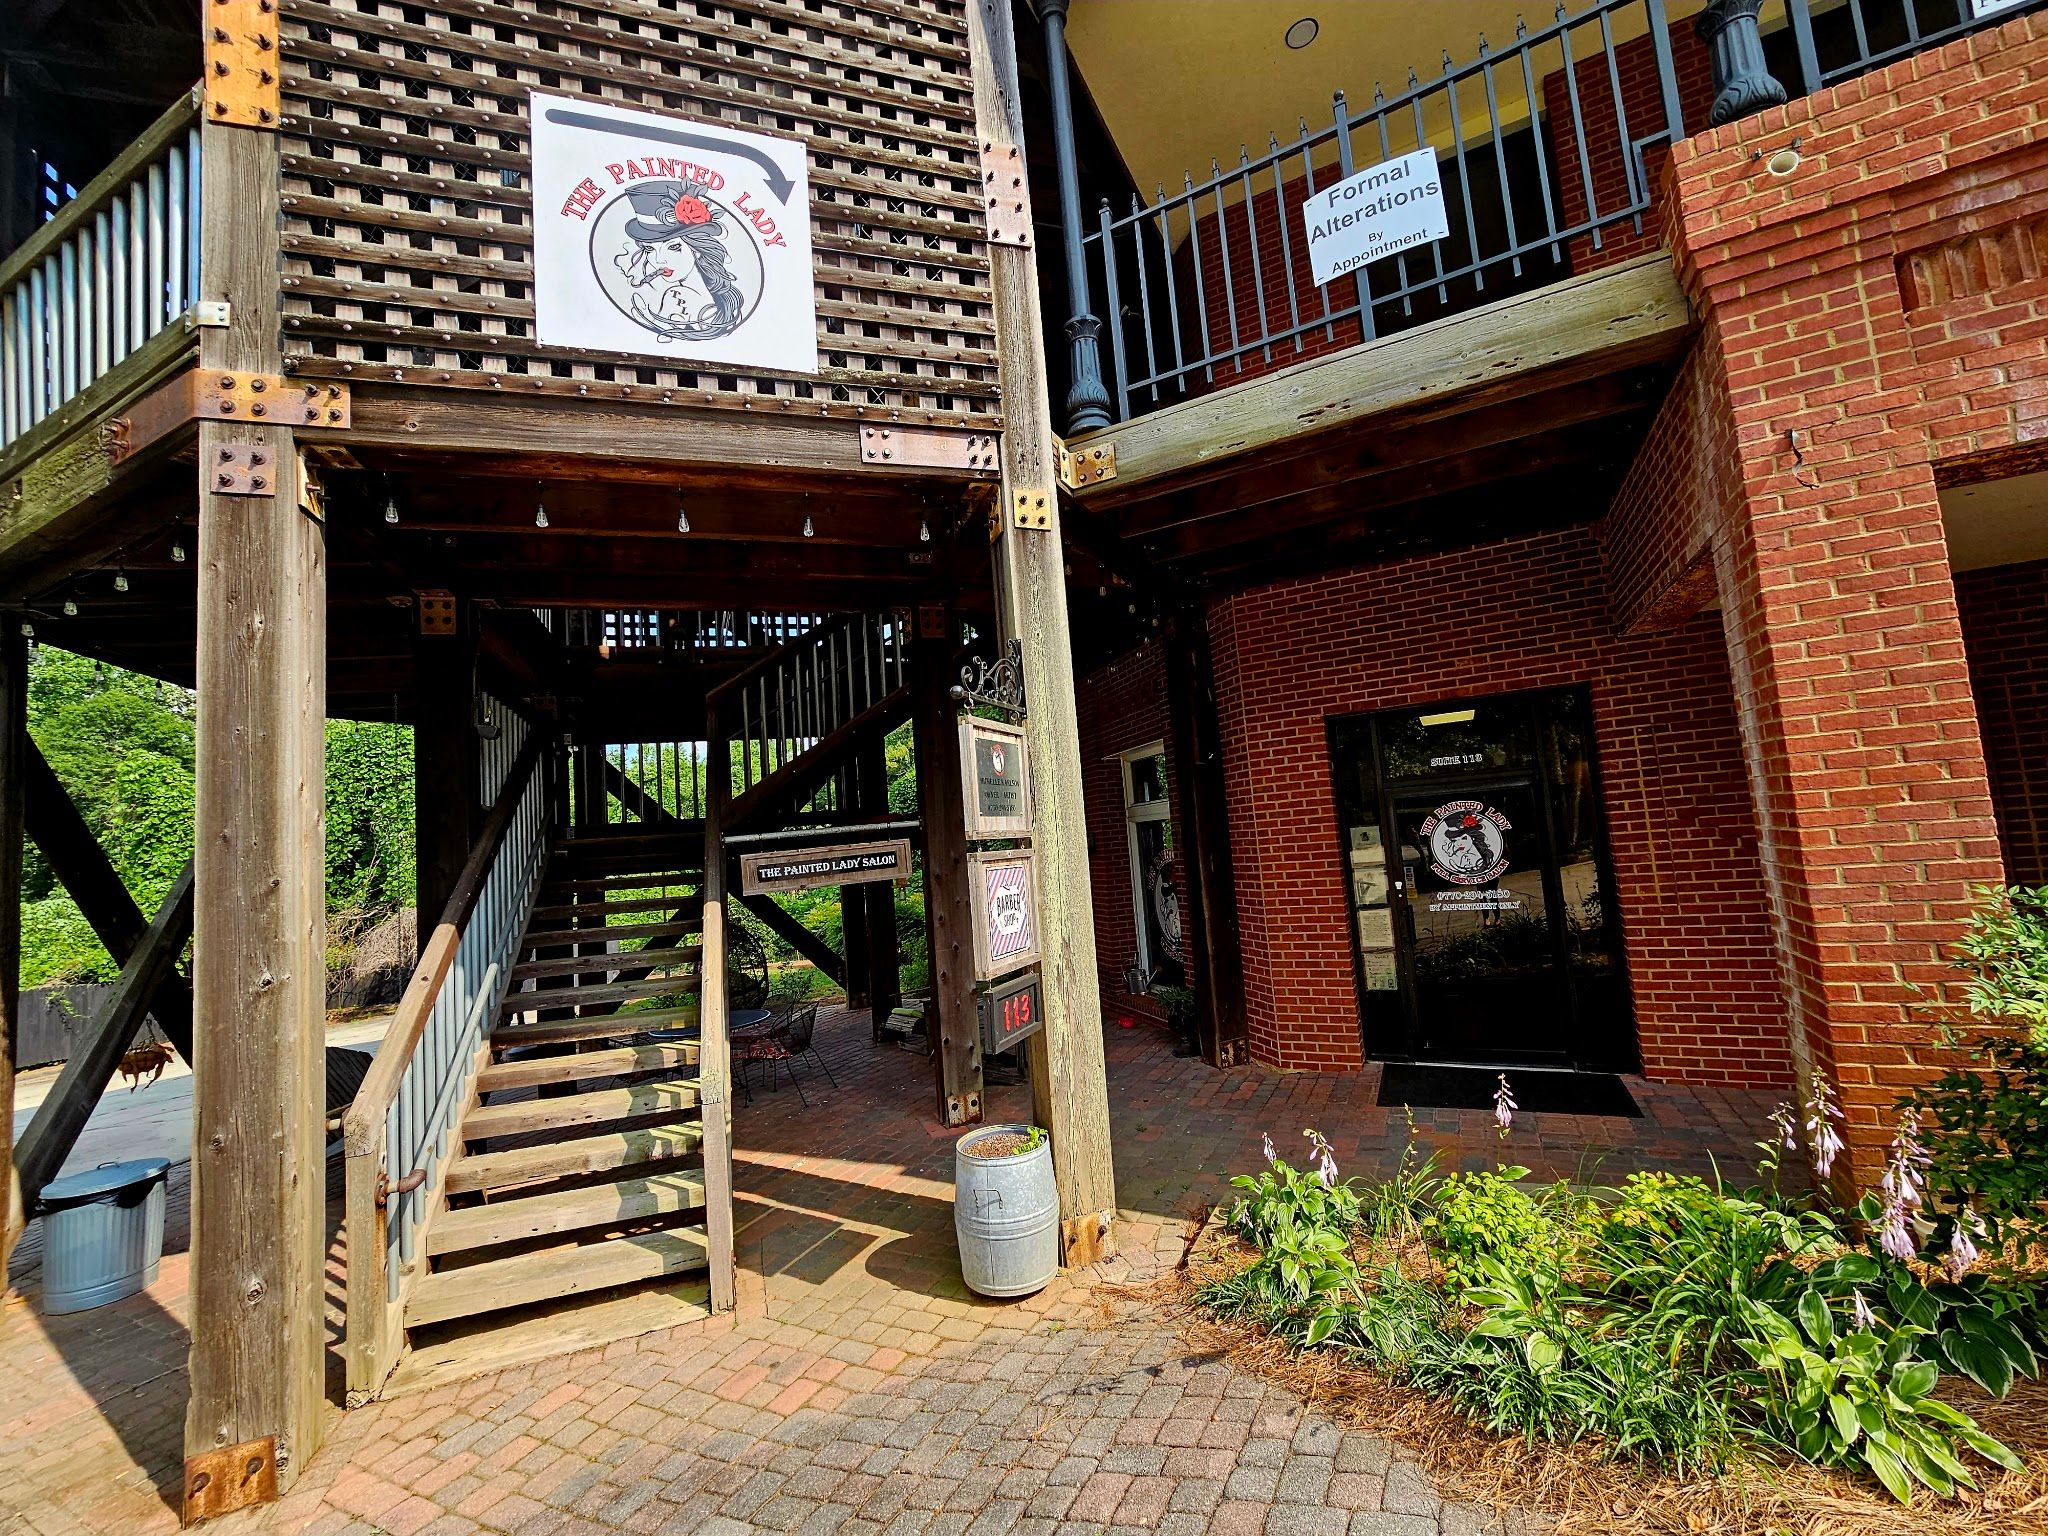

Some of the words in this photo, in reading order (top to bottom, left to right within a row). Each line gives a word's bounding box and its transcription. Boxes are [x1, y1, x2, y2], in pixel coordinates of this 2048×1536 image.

[1328, 160, 1410, 208] Formal
[561, 177, 606, 221] THE
[606, 157, 725, 191] PAINTED
[733, 191, 787, 249] LADY
[1311, 181, 1439, 244] Alterations
[1368, 231, 1384, 242] By
[1332, 228, 1428, 274] Appointment
[670, 289, 689, 317] TPL
[1430, 755, 1462, 767] SUITE
[1420, 816, 1438, 836] THE
[1434, 801, 1483, 819] PAINTED
[1485, 807, 1512, 831] LADY
[759, 867, 782, 879] THE
[784, 862, 830, 877] PAINTED
[832, 857, 861, 871] LADY
[862, 854, 896, 868] SALON
[1430, 862, 1450, 880] FULL
[1450, 875, 1489, 885] SERVICE
[997, 893, 1021, 918] BARBER
[1429, 903, 1442, 912] BY
[1442, 902, 1498, 911] APPOINTMENT
[1498, 900, 1521, 910] ONLY
[1003, 912, 1017, 928] SHOP
[1004, 994, 1031, 1033] 113
